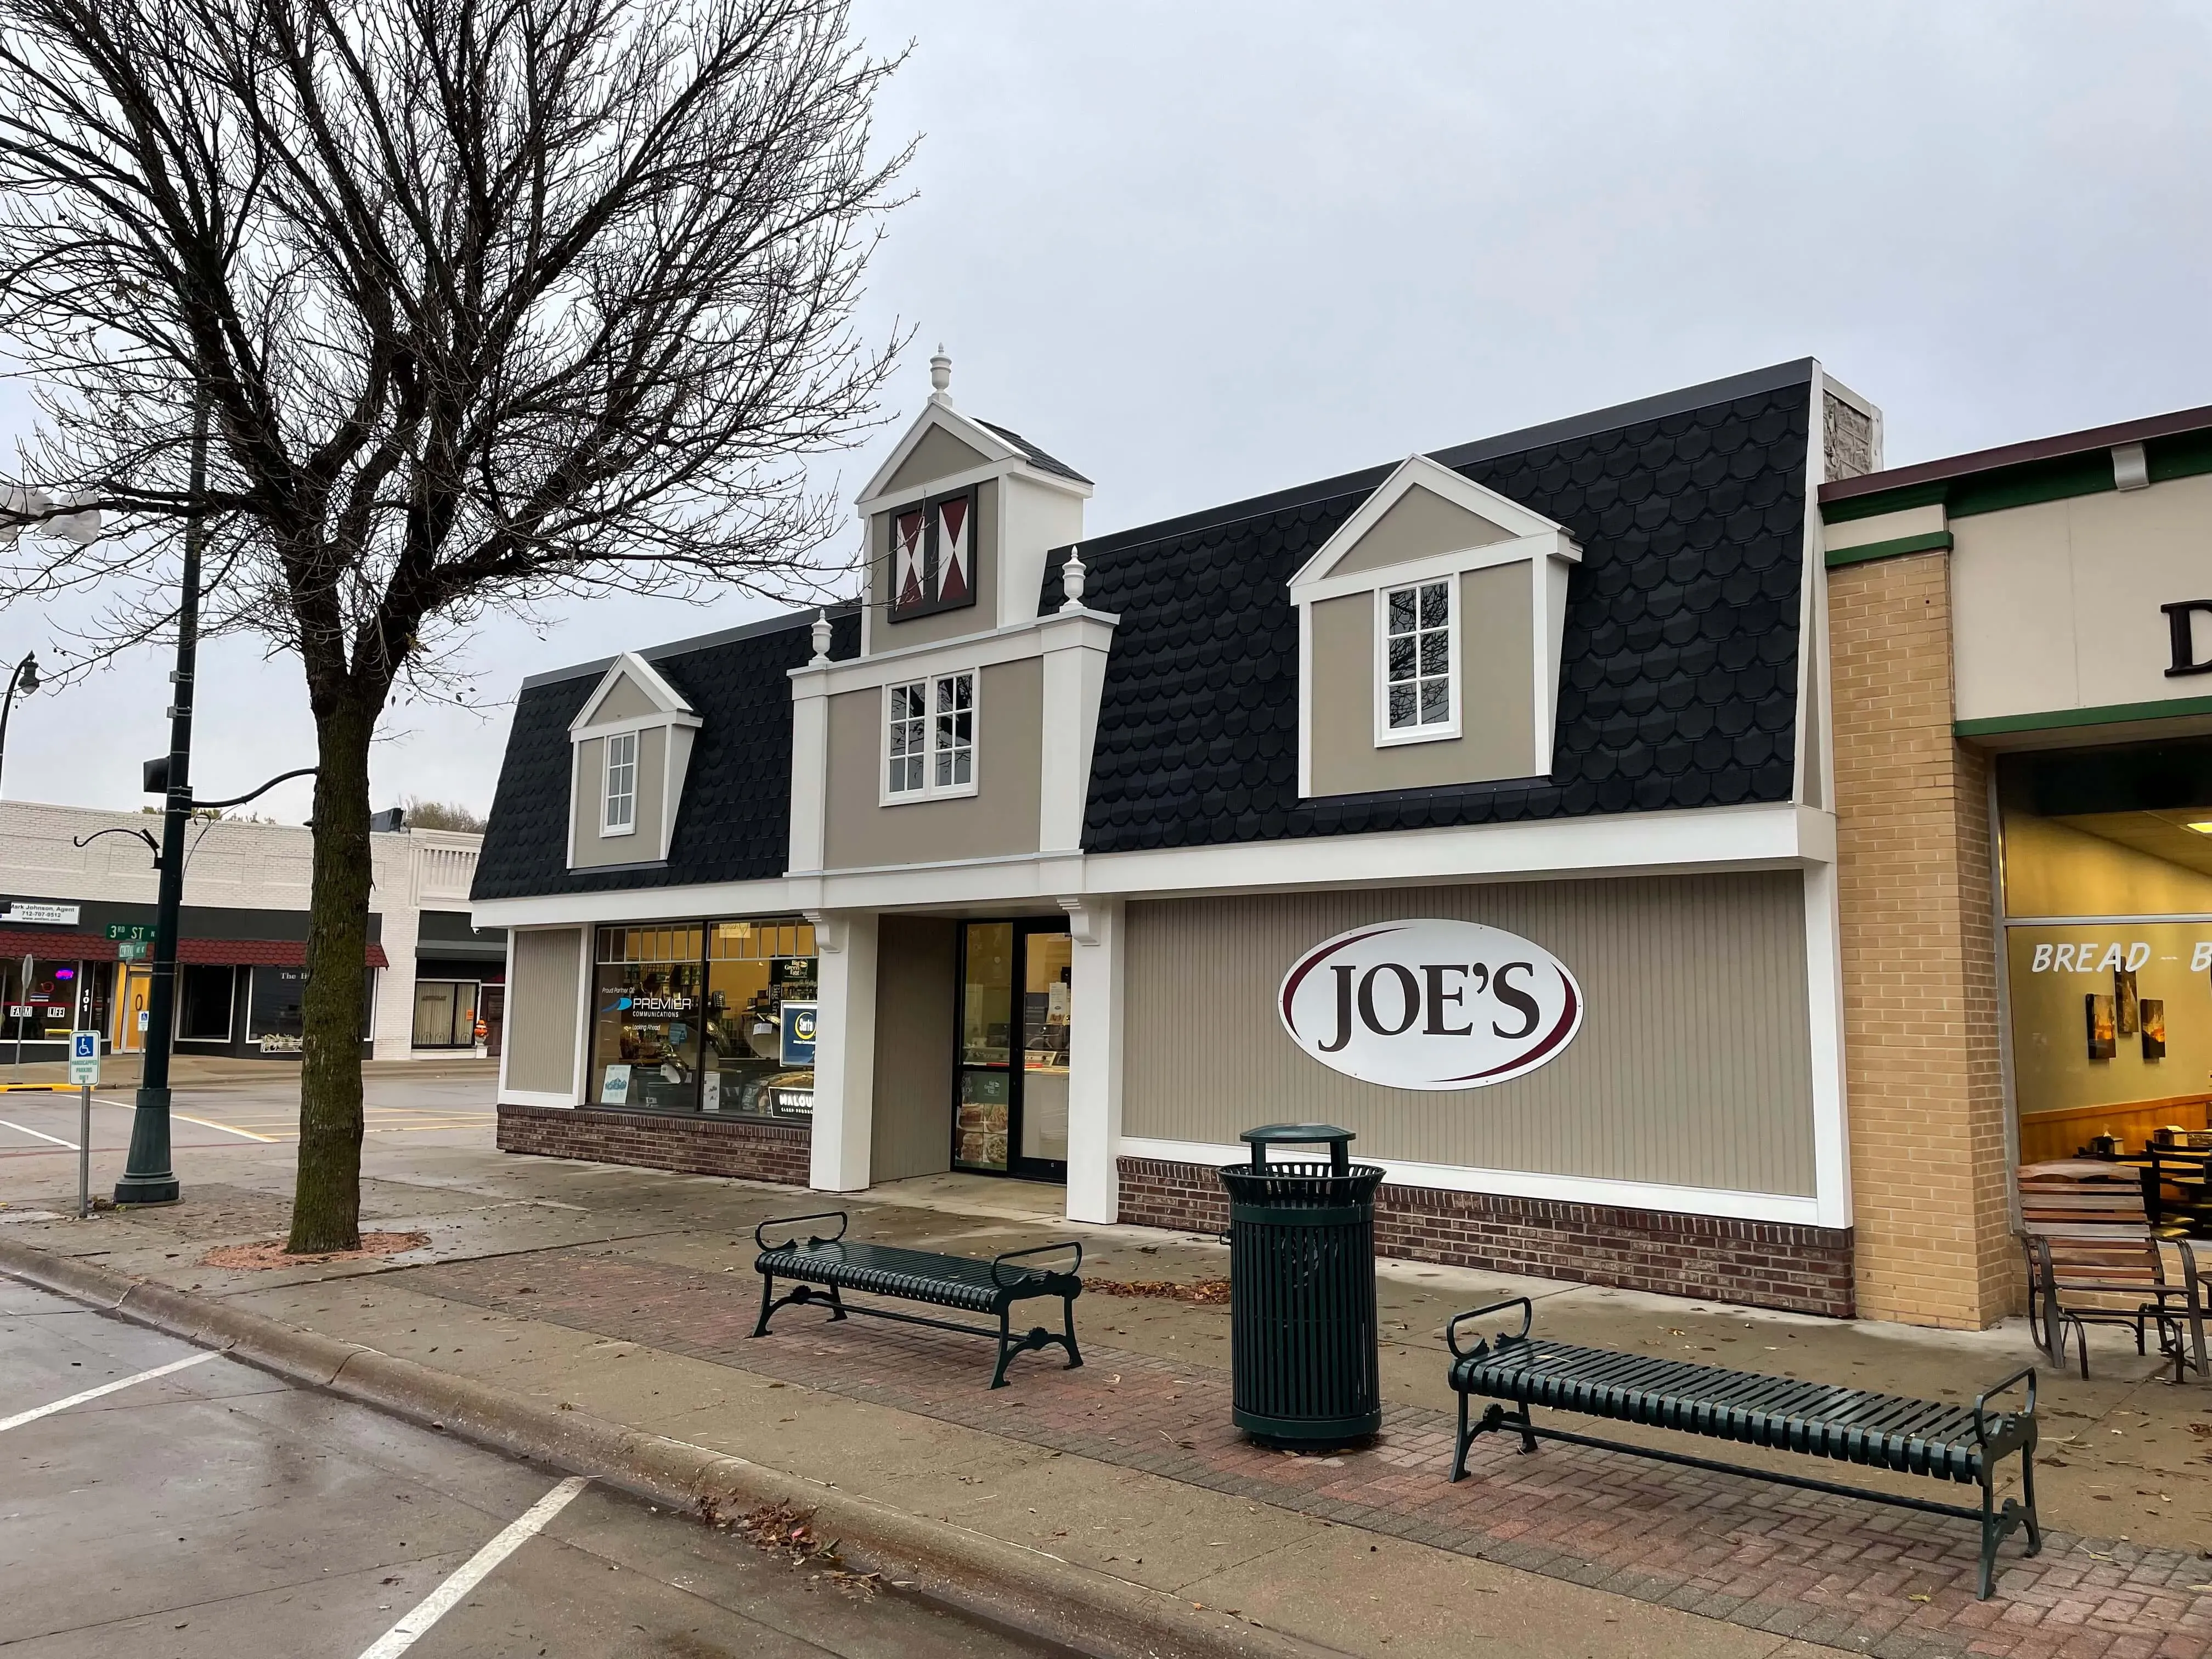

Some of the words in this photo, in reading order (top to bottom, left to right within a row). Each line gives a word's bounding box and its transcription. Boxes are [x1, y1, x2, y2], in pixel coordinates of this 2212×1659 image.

[110, 926, 125, 938] 3RD
[131, 927, 144, 939] ST
[2032, 942, 2151, 973] BREAD
[771, 984, 780, 1000] Big
[633, 998, 691, 1009] PREMIER
[1318, 962, 1540, 1052] JOE'S
[799, 1018, 813, 1031] Serta
[780, 1094, 814, 1107] MALOU
